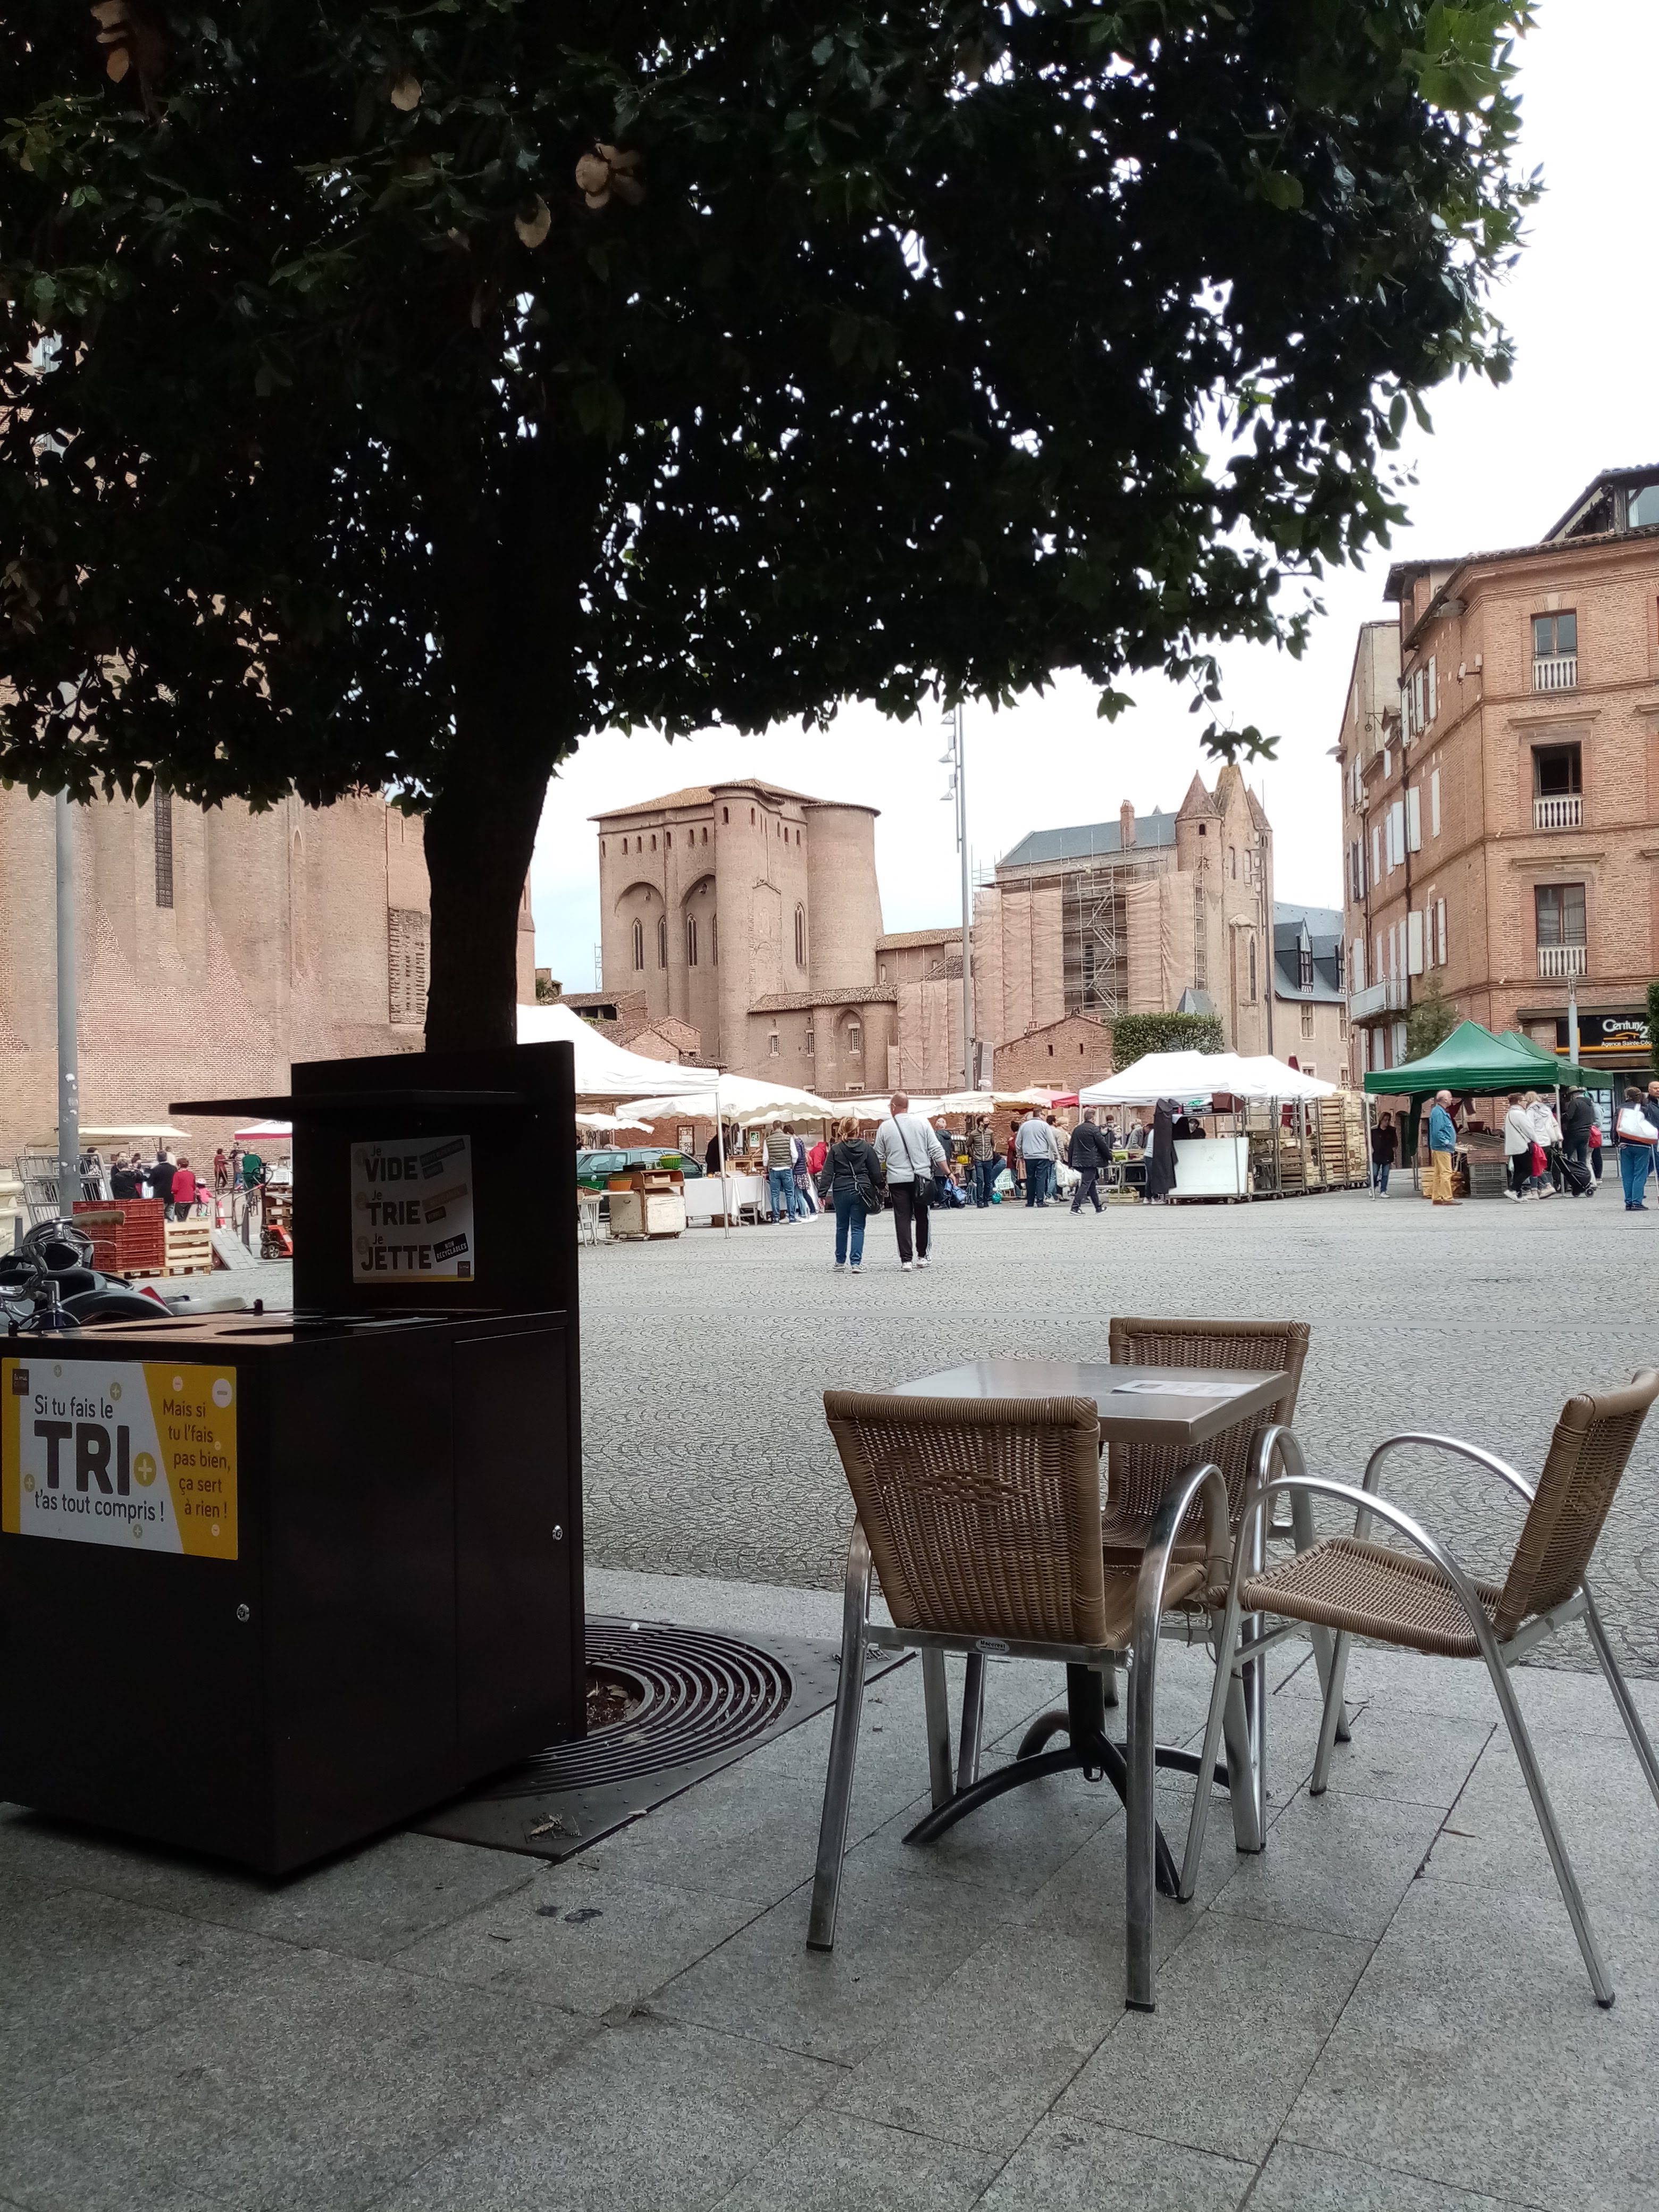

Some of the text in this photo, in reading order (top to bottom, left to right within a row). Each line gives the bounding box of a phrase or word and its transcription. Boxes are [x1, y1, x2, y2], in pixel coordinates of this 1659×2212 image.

[1603, 1019, 1644, 1033] Century
[1639, 1026, 1650, 1038] 2
[371, 1145, 382, 1157] Je
[365, 1155, 418, 1183] VIDE
[372, 1190, 382, 1201] Je
[366, 1200, 421, 1227] TRIE
[373, 1233, 383, 1245] Je
[361, 1244, 432, 1271] JETTE
[436, 1243, 467, 1260] RECYCLABLES
[35, 1395, 113, 1419] Si tu fais le
[163, 1398, 206, 1418] Mais si
[168, 1424, 214, 1443] tu l'fais
[34, 1420, 130, 1496] TRI
[174, 1449, 231, 1473] pas bien,
[179, 1477, 222, 1495] ça sert
[35, 1489, 57, 1510] t'as
[62, 1494, 90, 1514] tout
[95, 1501, 155, 1524] compris
[185, 1498, 192, 1515] à
[196, 1501, 220, 1518] rien
